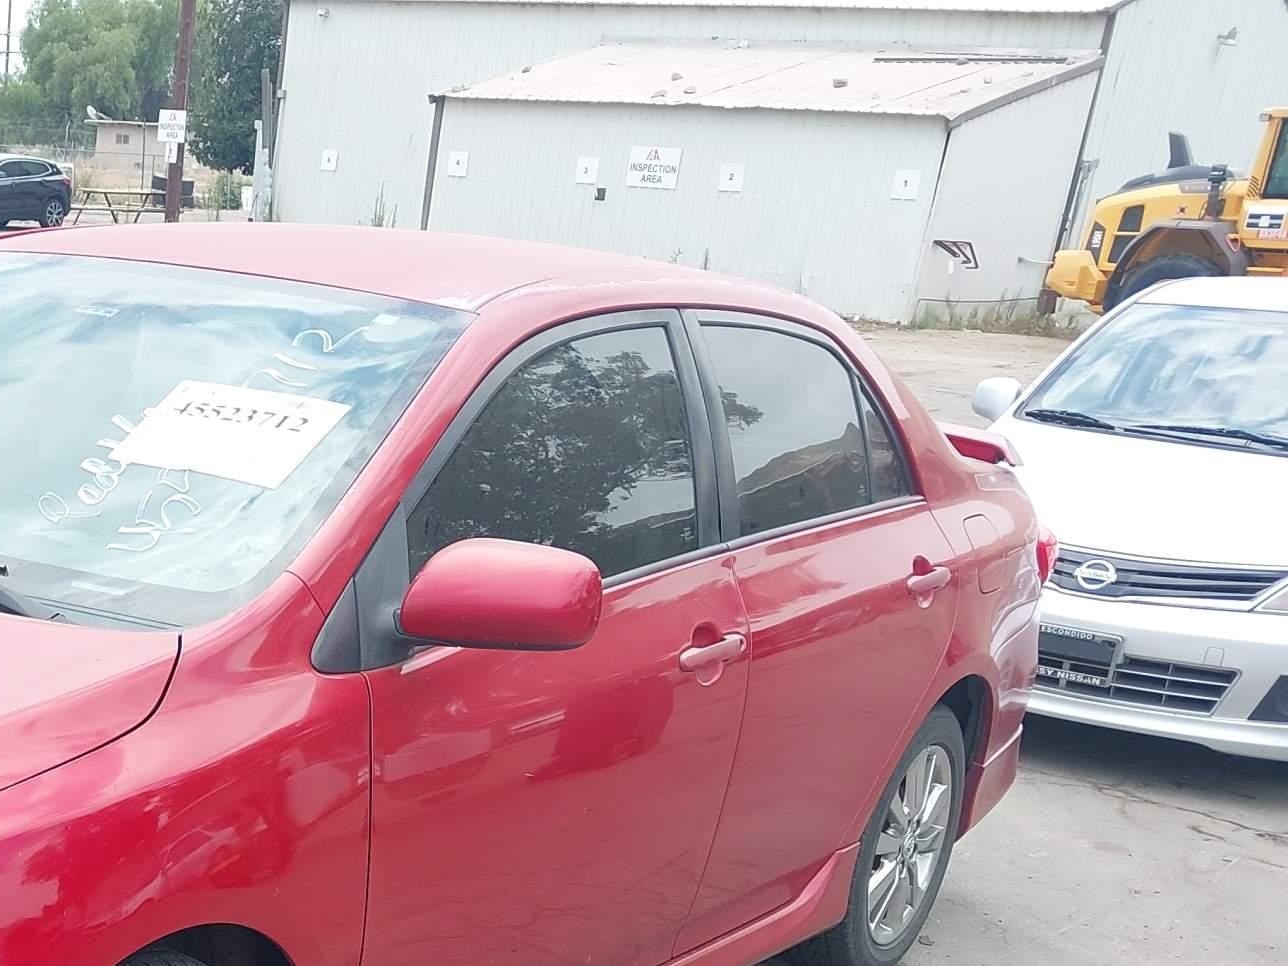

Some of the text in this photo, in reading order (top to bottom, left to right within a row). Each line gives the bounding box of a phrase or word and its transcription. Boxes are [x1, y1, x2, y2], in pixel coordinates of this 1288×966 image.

[630, 162, 677, 174] INSPECTION
[640, 174, 663, 184] AREA
[174, 402, 309, 432] 45523712
[1040, 625, 1093, 640] ESCONDIDO
[1057, 671, 1101, 685] NISSAN
